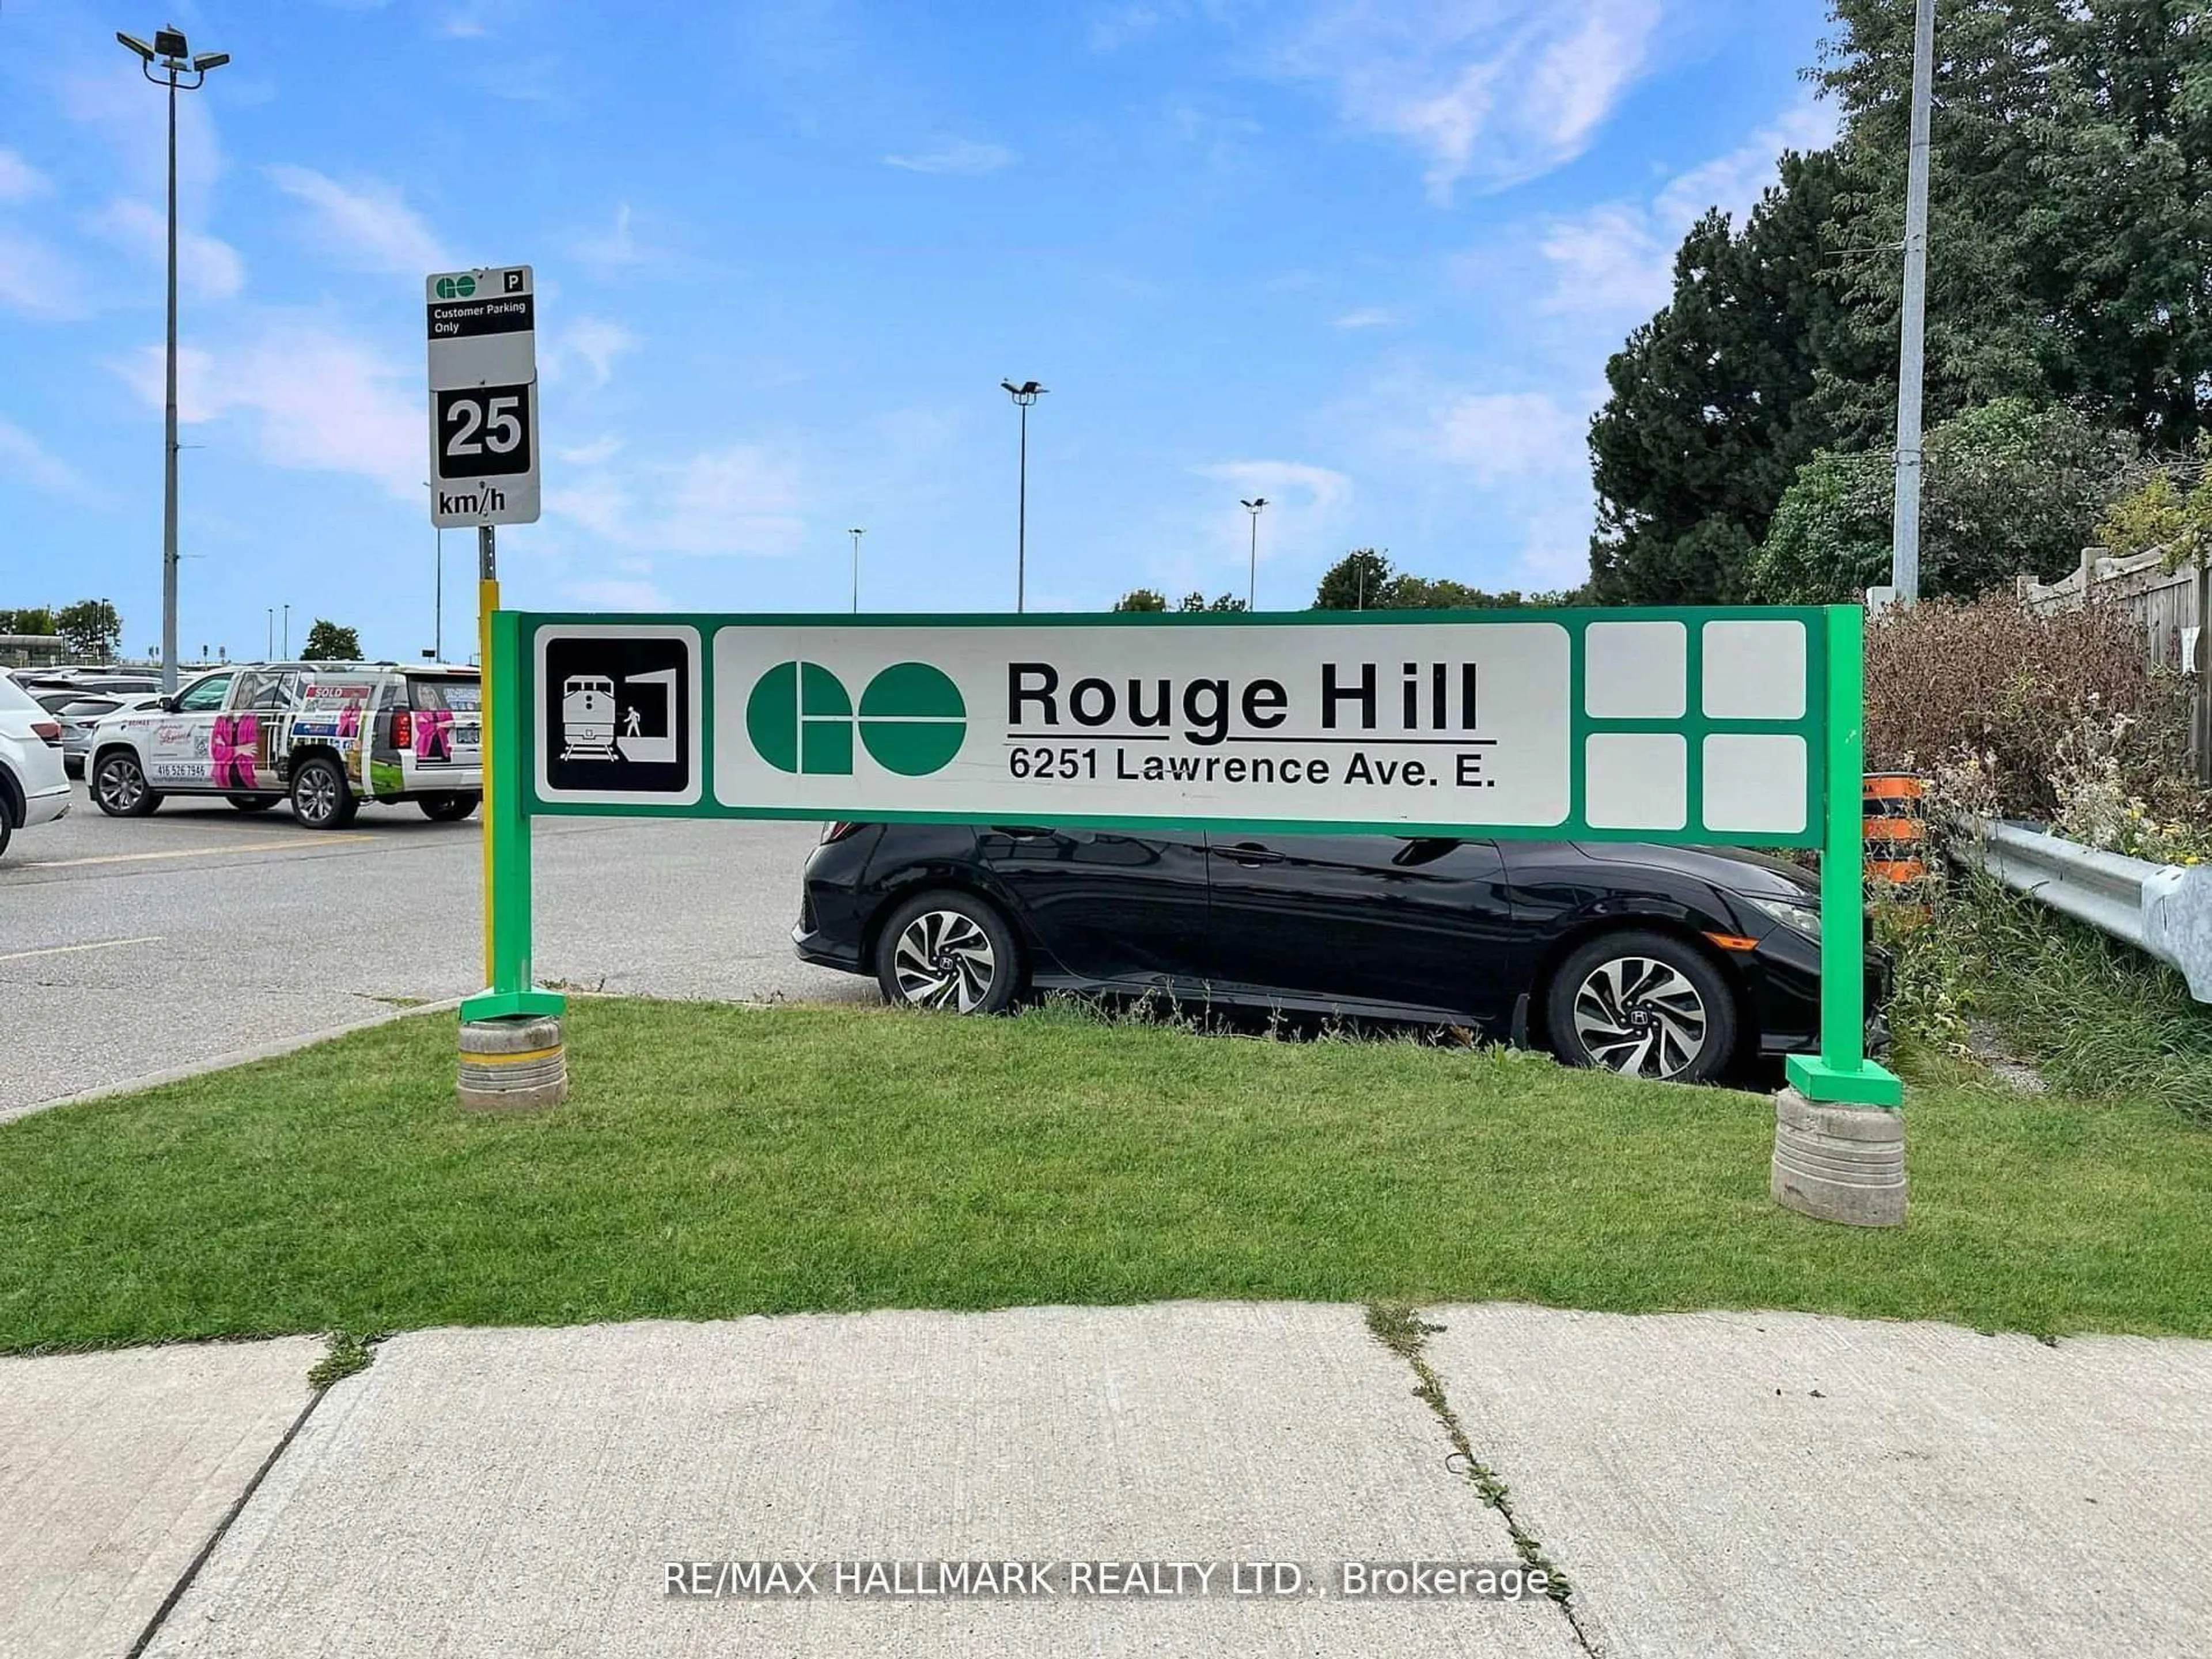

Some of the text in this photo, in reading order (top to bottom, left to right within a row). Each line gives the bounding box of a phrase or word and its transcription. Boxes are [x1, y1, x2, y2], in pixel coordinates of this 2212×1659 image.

[508, 275, 519, 289] P
[434, 302, 526, 319] Customer Parking
[434, 321, 460, 334] Only
[446, 395, 522, 456] 25
[439, 487, 505, 514] km/h
[315, 688, 343, 698] SOLD
[1008, 662, 1477, 746] Rouge Hill
[1009, 748, 1495, 787] 6251 Lawrence Ave. E.
